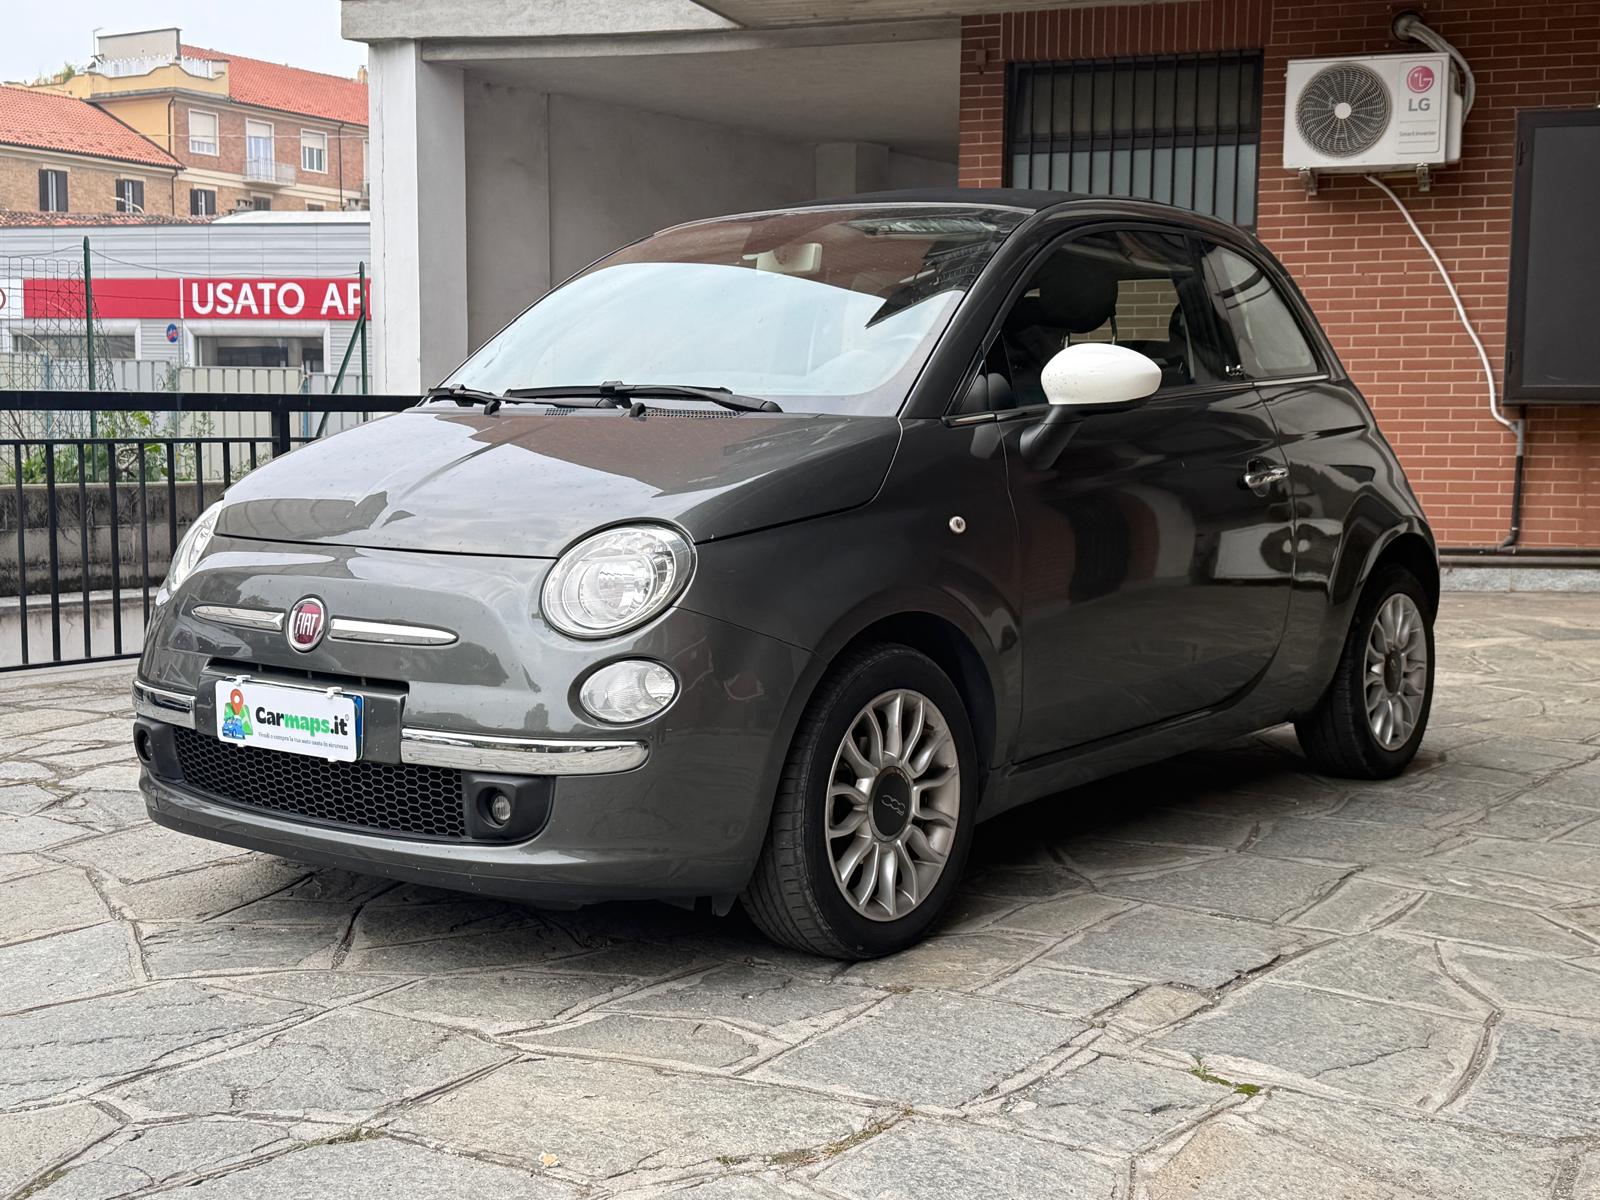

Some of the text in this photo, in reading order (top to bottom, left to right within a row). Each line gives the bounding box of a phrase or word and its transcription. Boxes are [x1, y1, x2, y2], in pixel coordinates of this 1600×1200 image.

[1408, 97, 1431, 112] LG
[191, 282, 372, 315] USATO AP
[295, 612, 319, 636] FIAT
[255, 706, 348, 737] Carmaps.it
